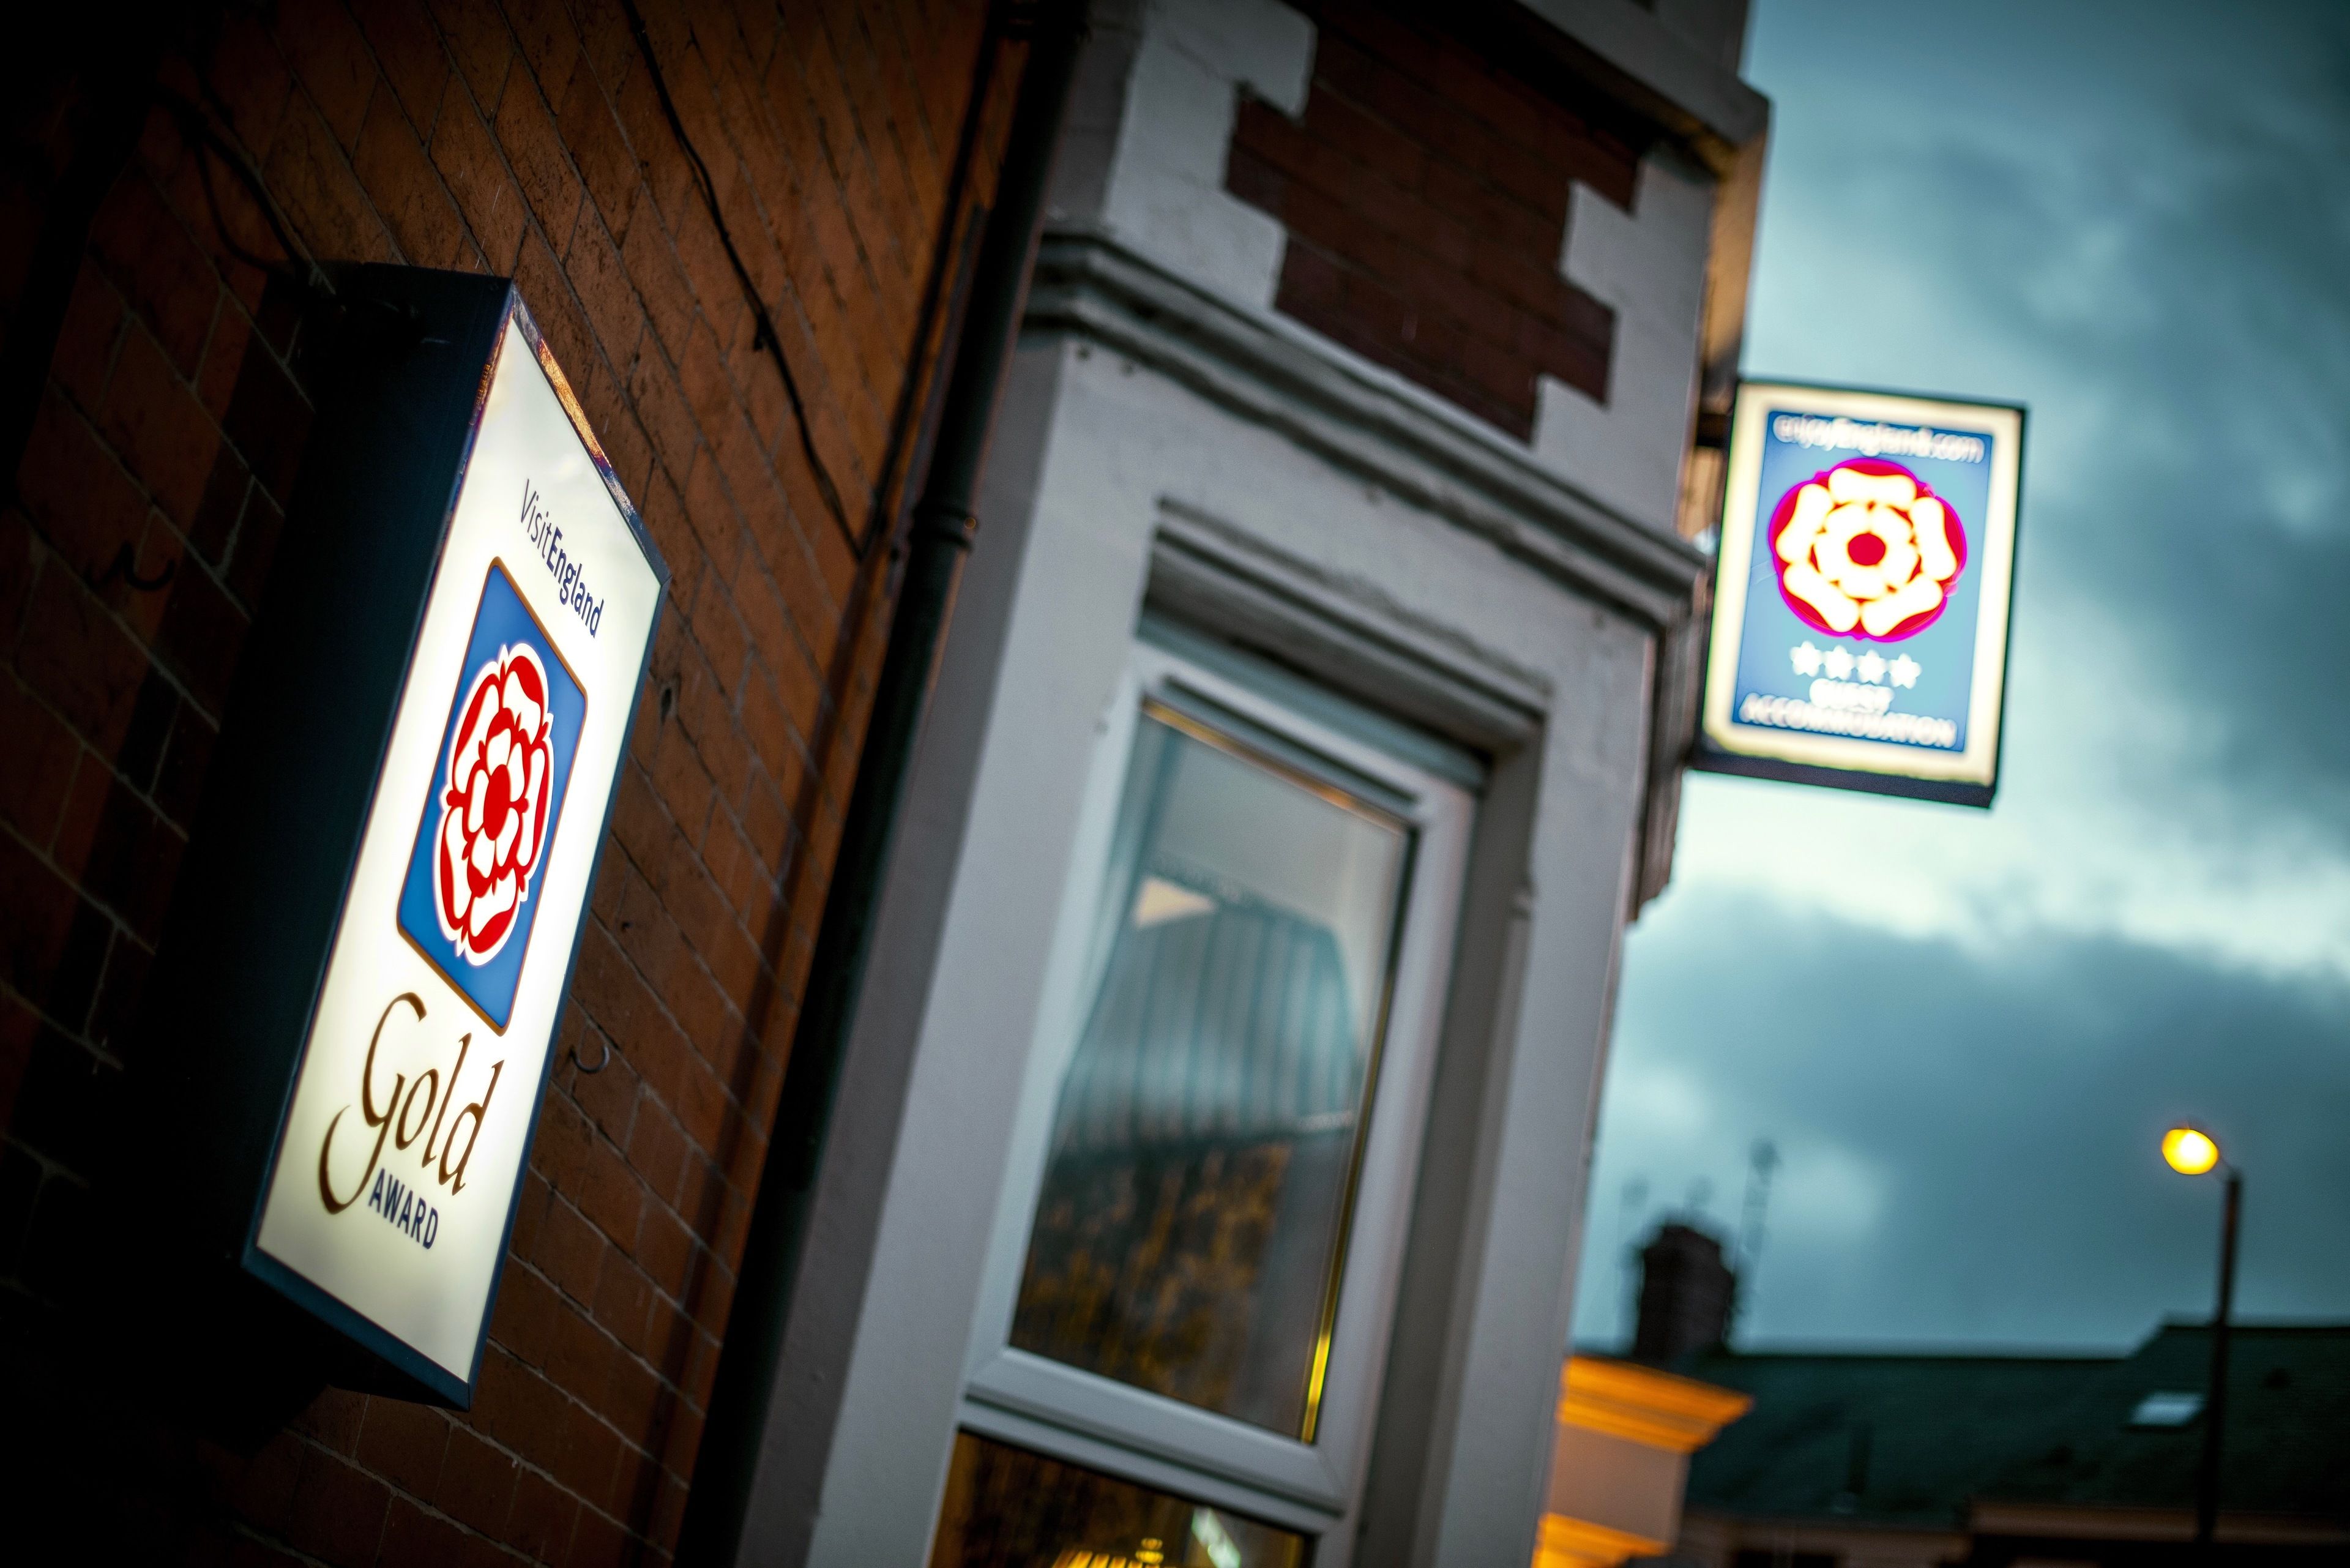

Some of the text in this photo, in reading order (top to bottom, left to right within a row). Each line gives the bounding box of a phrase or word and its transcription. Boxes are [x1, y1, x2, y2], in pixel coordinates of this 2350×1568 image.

[521, 478, 605, 638] VisitEngland
[319, 992, 505, 1214] Gold
[368, 1168, 439, 1249] AWARD
